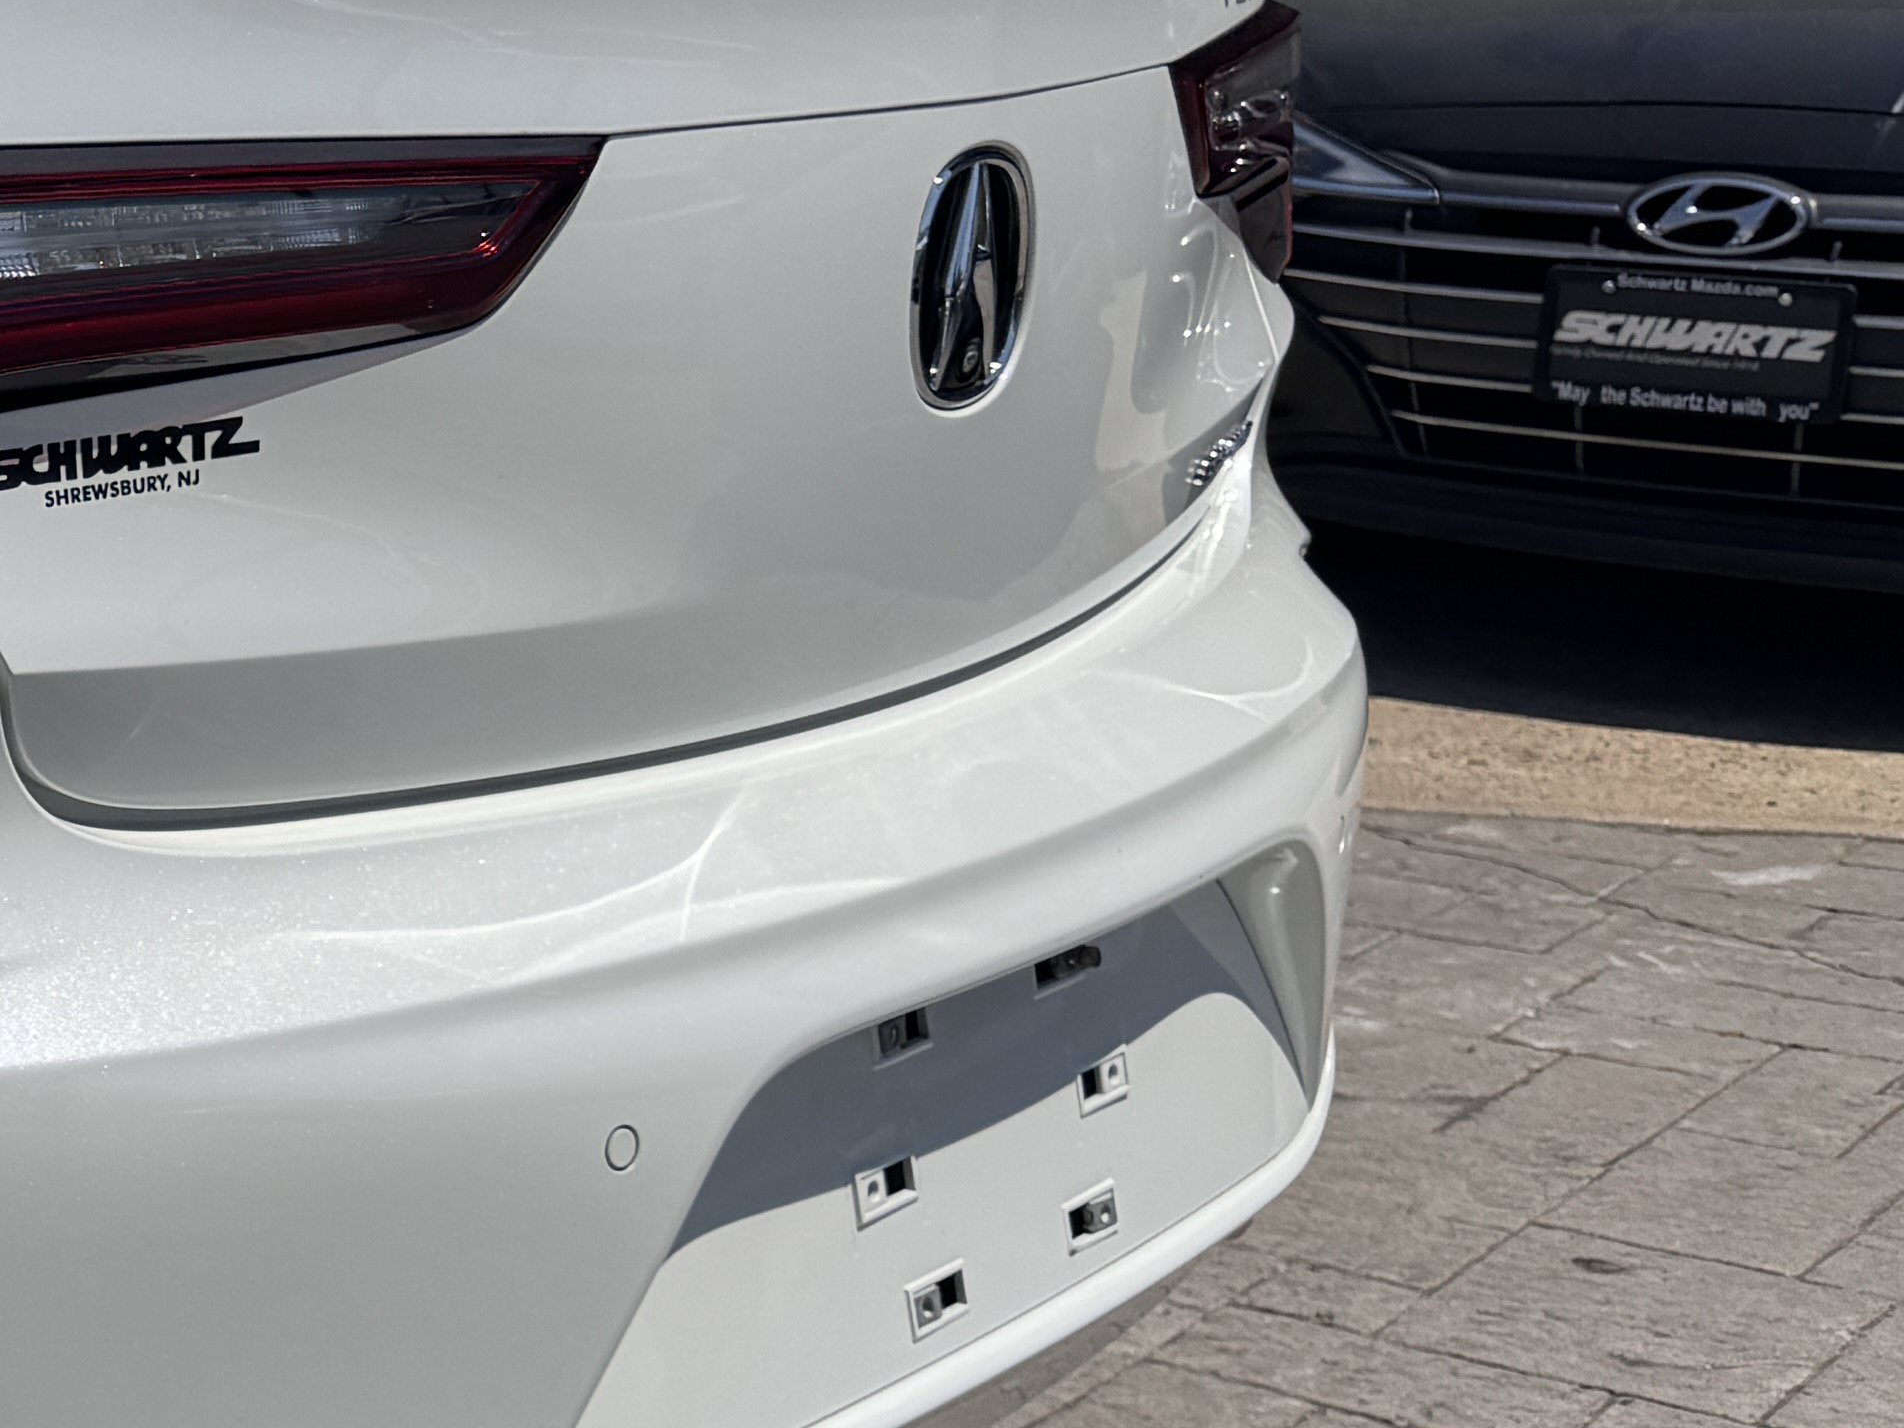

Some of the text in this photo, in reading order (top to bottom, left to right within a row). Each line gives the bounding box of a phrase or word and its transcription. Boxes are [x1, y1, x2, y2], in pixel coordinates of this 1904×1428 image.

[1554, 310, 1837, 362] SCHWARTZ
[1600, 385, 1627, 405] the
[1629, 386, 1704, 412] Schwartz
[1706, 393, 1728, 414] be
[1731, 396, 1766, 417] with
[44, 468, 200, 508] SHREWSBURY, NJ
